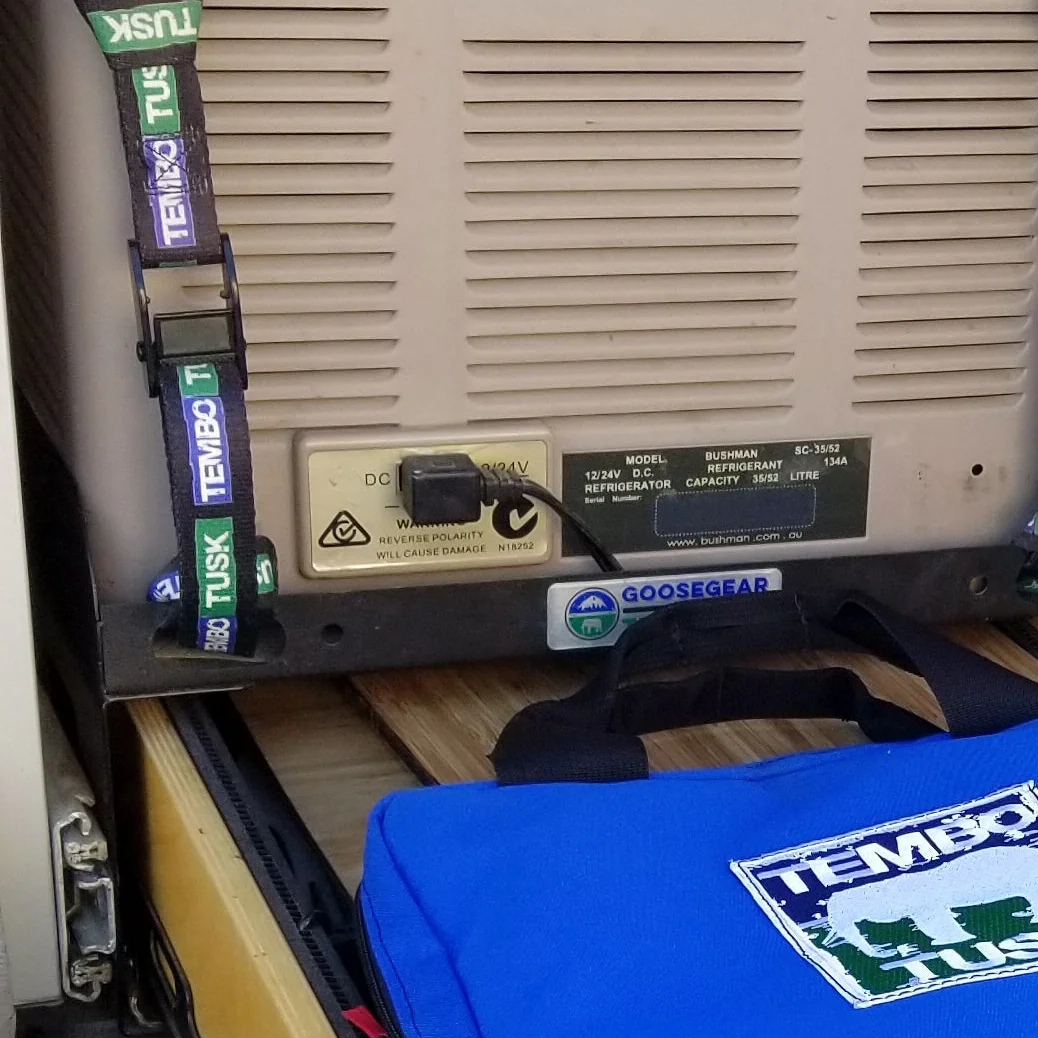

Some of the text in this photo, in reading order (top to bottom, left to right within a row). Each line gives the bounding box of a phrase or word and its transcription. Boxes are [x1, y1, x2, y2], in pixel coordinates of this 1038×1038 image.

[103, 7, 197, 43] TUSK
[141, 65, 174, 124] TUS
[191, 398, 226, 503] TEMBO
[705, 449, 758, 461] BUSHMAN
[365, 473, 391, 486] DC
[585, 469, 621, 480] 12/24V
[708, 460, 783, 474] REFRIGERANT
[824, 456, 848, 467] 134A
[585, 471, 820, 494] REFRIGERATOR CAPACITY 35/52 LITRE
[380, 531, 484, 545] REVERSE POLARITY
[377, 545, 487, 560] WILL CAUSE DAMAGE
[204, 531, 231, 609] TUSK
[622, 577, 769, 602] GOOSEGEAR
[204, 617, 231, 653] EMBO
[758, 804, 1036, 895] TEMBO
